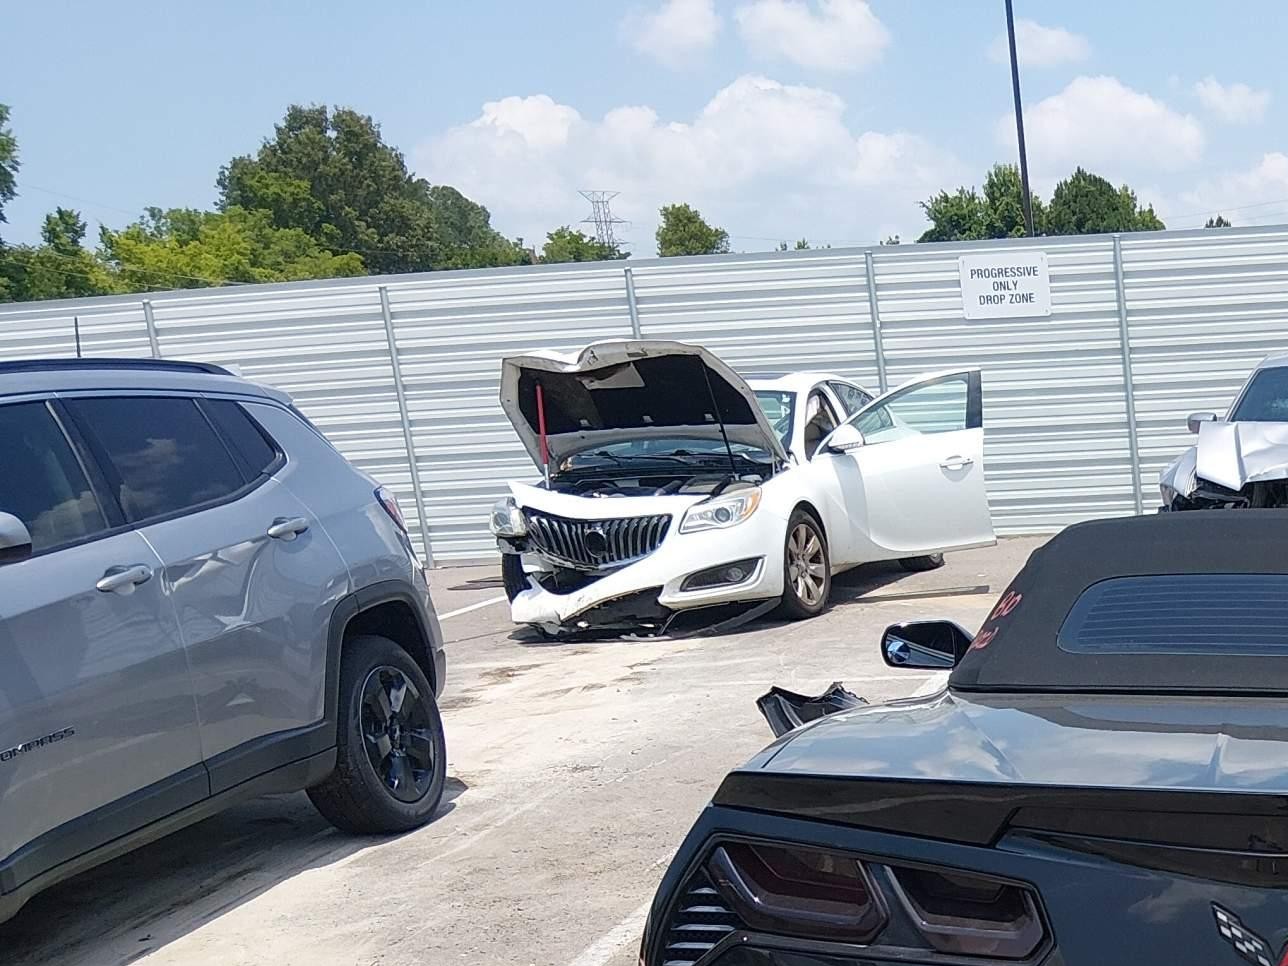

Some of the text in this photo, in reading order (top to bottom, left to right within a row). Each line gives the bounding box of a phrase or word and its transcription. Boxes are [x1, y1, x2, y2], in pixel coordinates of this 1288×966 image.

[970, 266, 1039, 279] PROGRESSIVE
[992, 280, 1018, 291] ONLY
[979, 292, 1035, 306] DROP ZONE
